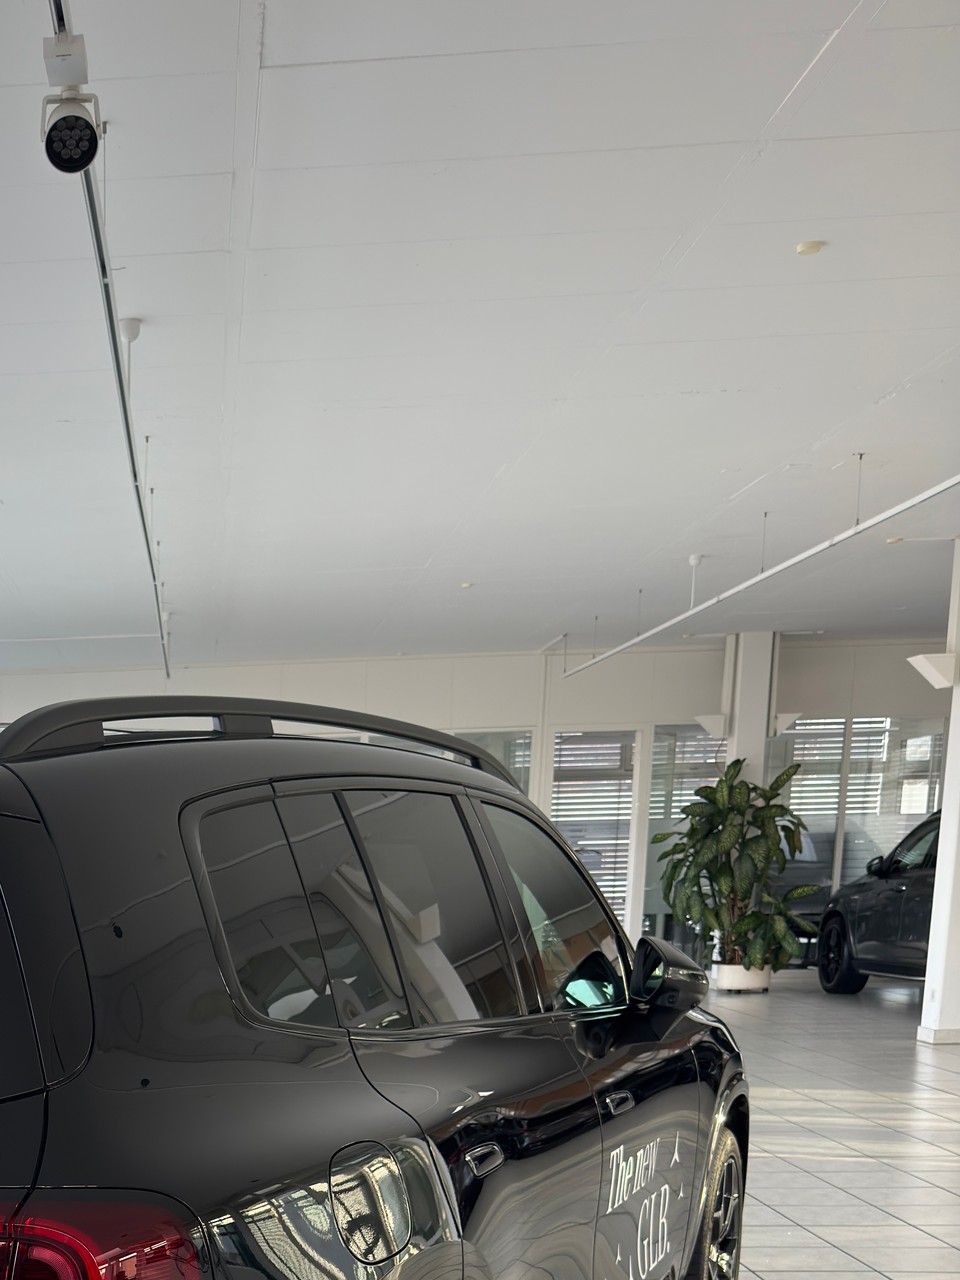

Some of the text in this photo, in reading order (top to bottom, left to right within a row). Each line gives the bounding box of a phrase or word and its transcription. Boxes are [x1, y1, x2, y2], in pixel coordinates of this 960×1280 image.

[606, 1137, 660, 1214] The new
[637, 1183, 670, 1280] GLB.
